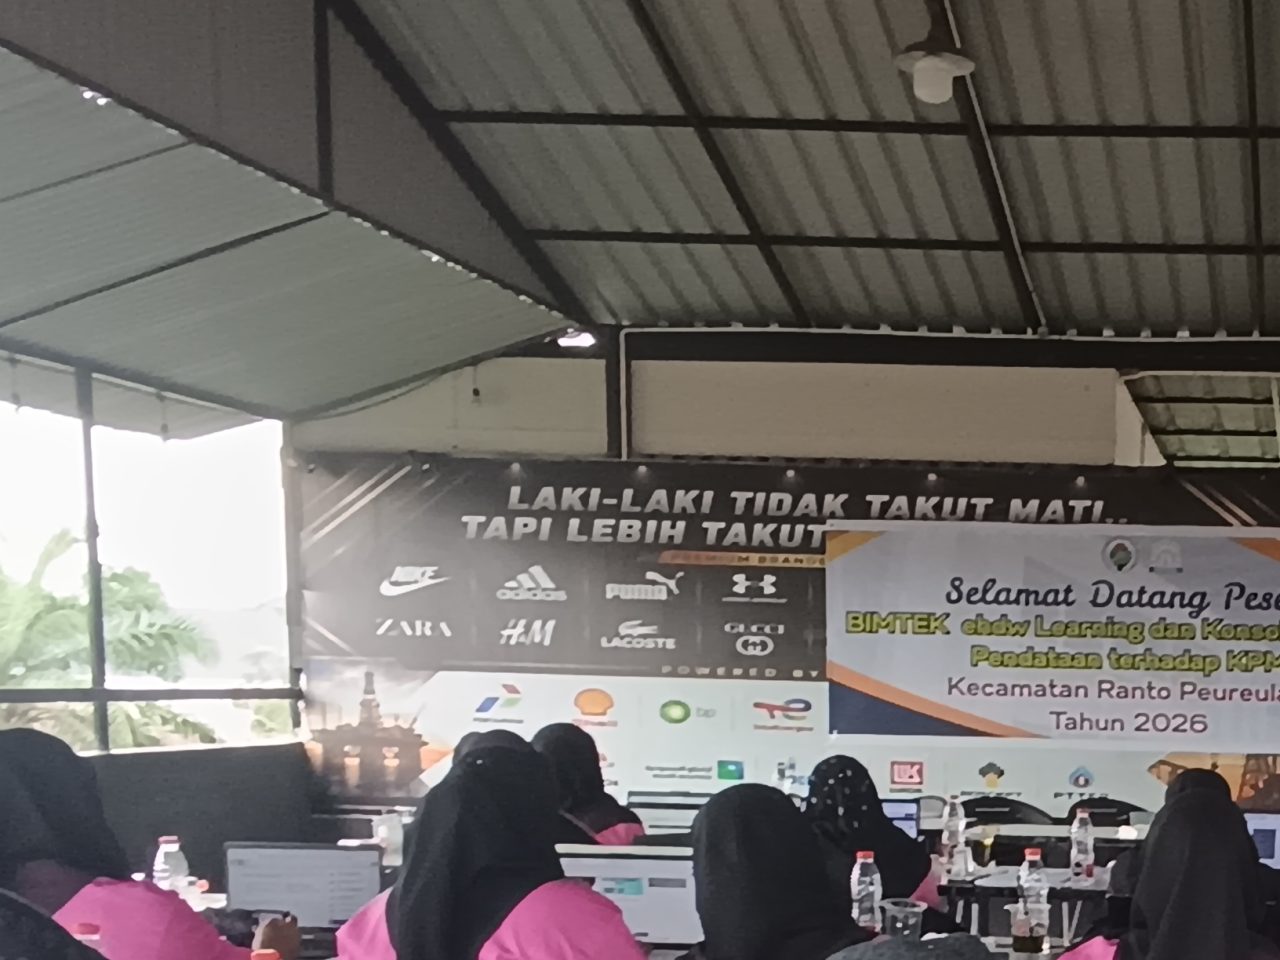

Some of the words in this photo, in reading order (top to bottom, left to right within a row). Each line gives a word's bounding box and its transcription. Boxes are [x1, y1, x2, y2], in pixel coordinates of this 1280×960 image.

[507, 485, 715, 514] LAKI-LAKI
[729, 490, 849, 518] TIDAK
[865, 494, 994, 521] TAKUT
[460, 515, 553, 541] TAPI
[566, 517, 686, 545] LEBIH
[701, 521, 827, 548] TAKUT
[945, 575, 1078, 607] Selamat
[1089, 579, 1211, 619] Datang
[600, 636, 677, 650] LACOSTE
[845, 610, 951, 635] BIMTEK
[1034, 614, 1146, 644] Learning
[1149, 617, 1196, 641] dan
[661, 664, 778, 678] POWERED
[969, 644, 1104, 670] Pendataan
[1106, 647, 1222, 677] terhadap
[946, 677, 1089, 699] Kecamatan
[1097, 679, 1172, 701] Ranto
[1049, 710, 1125, 733] Tahun
[1133, 712, 1209, 734] 2026
